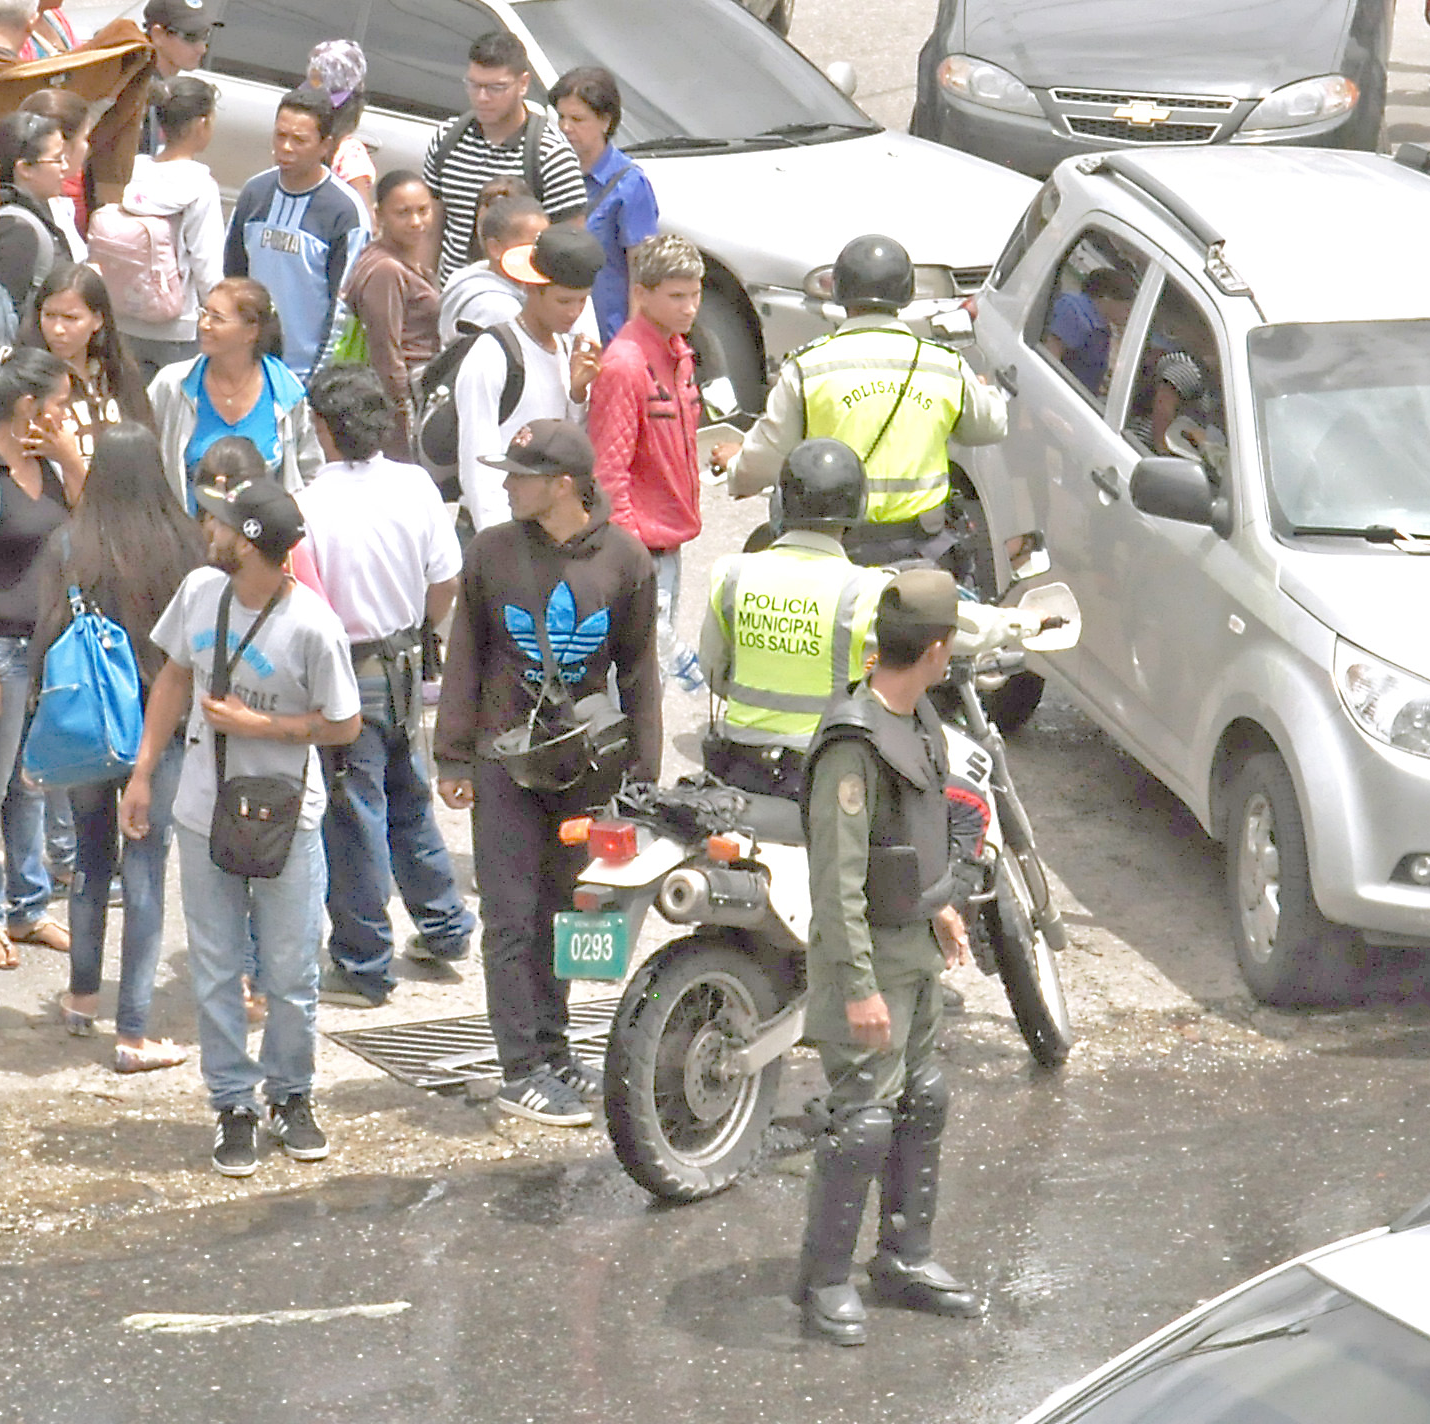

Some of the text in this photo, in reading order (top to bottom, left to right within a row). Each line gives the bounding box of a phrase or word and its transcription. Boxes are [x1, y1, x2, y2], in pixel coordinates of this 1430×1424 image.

[261, 228, 300, 255] PMA
[743, 592, 819, 616] POLICÍA
[738, 610, 822, 638] MUNICIPAL
[739, 631, 819, 657] LOS SALIAS
[571, 933, 613, 961] 0293
